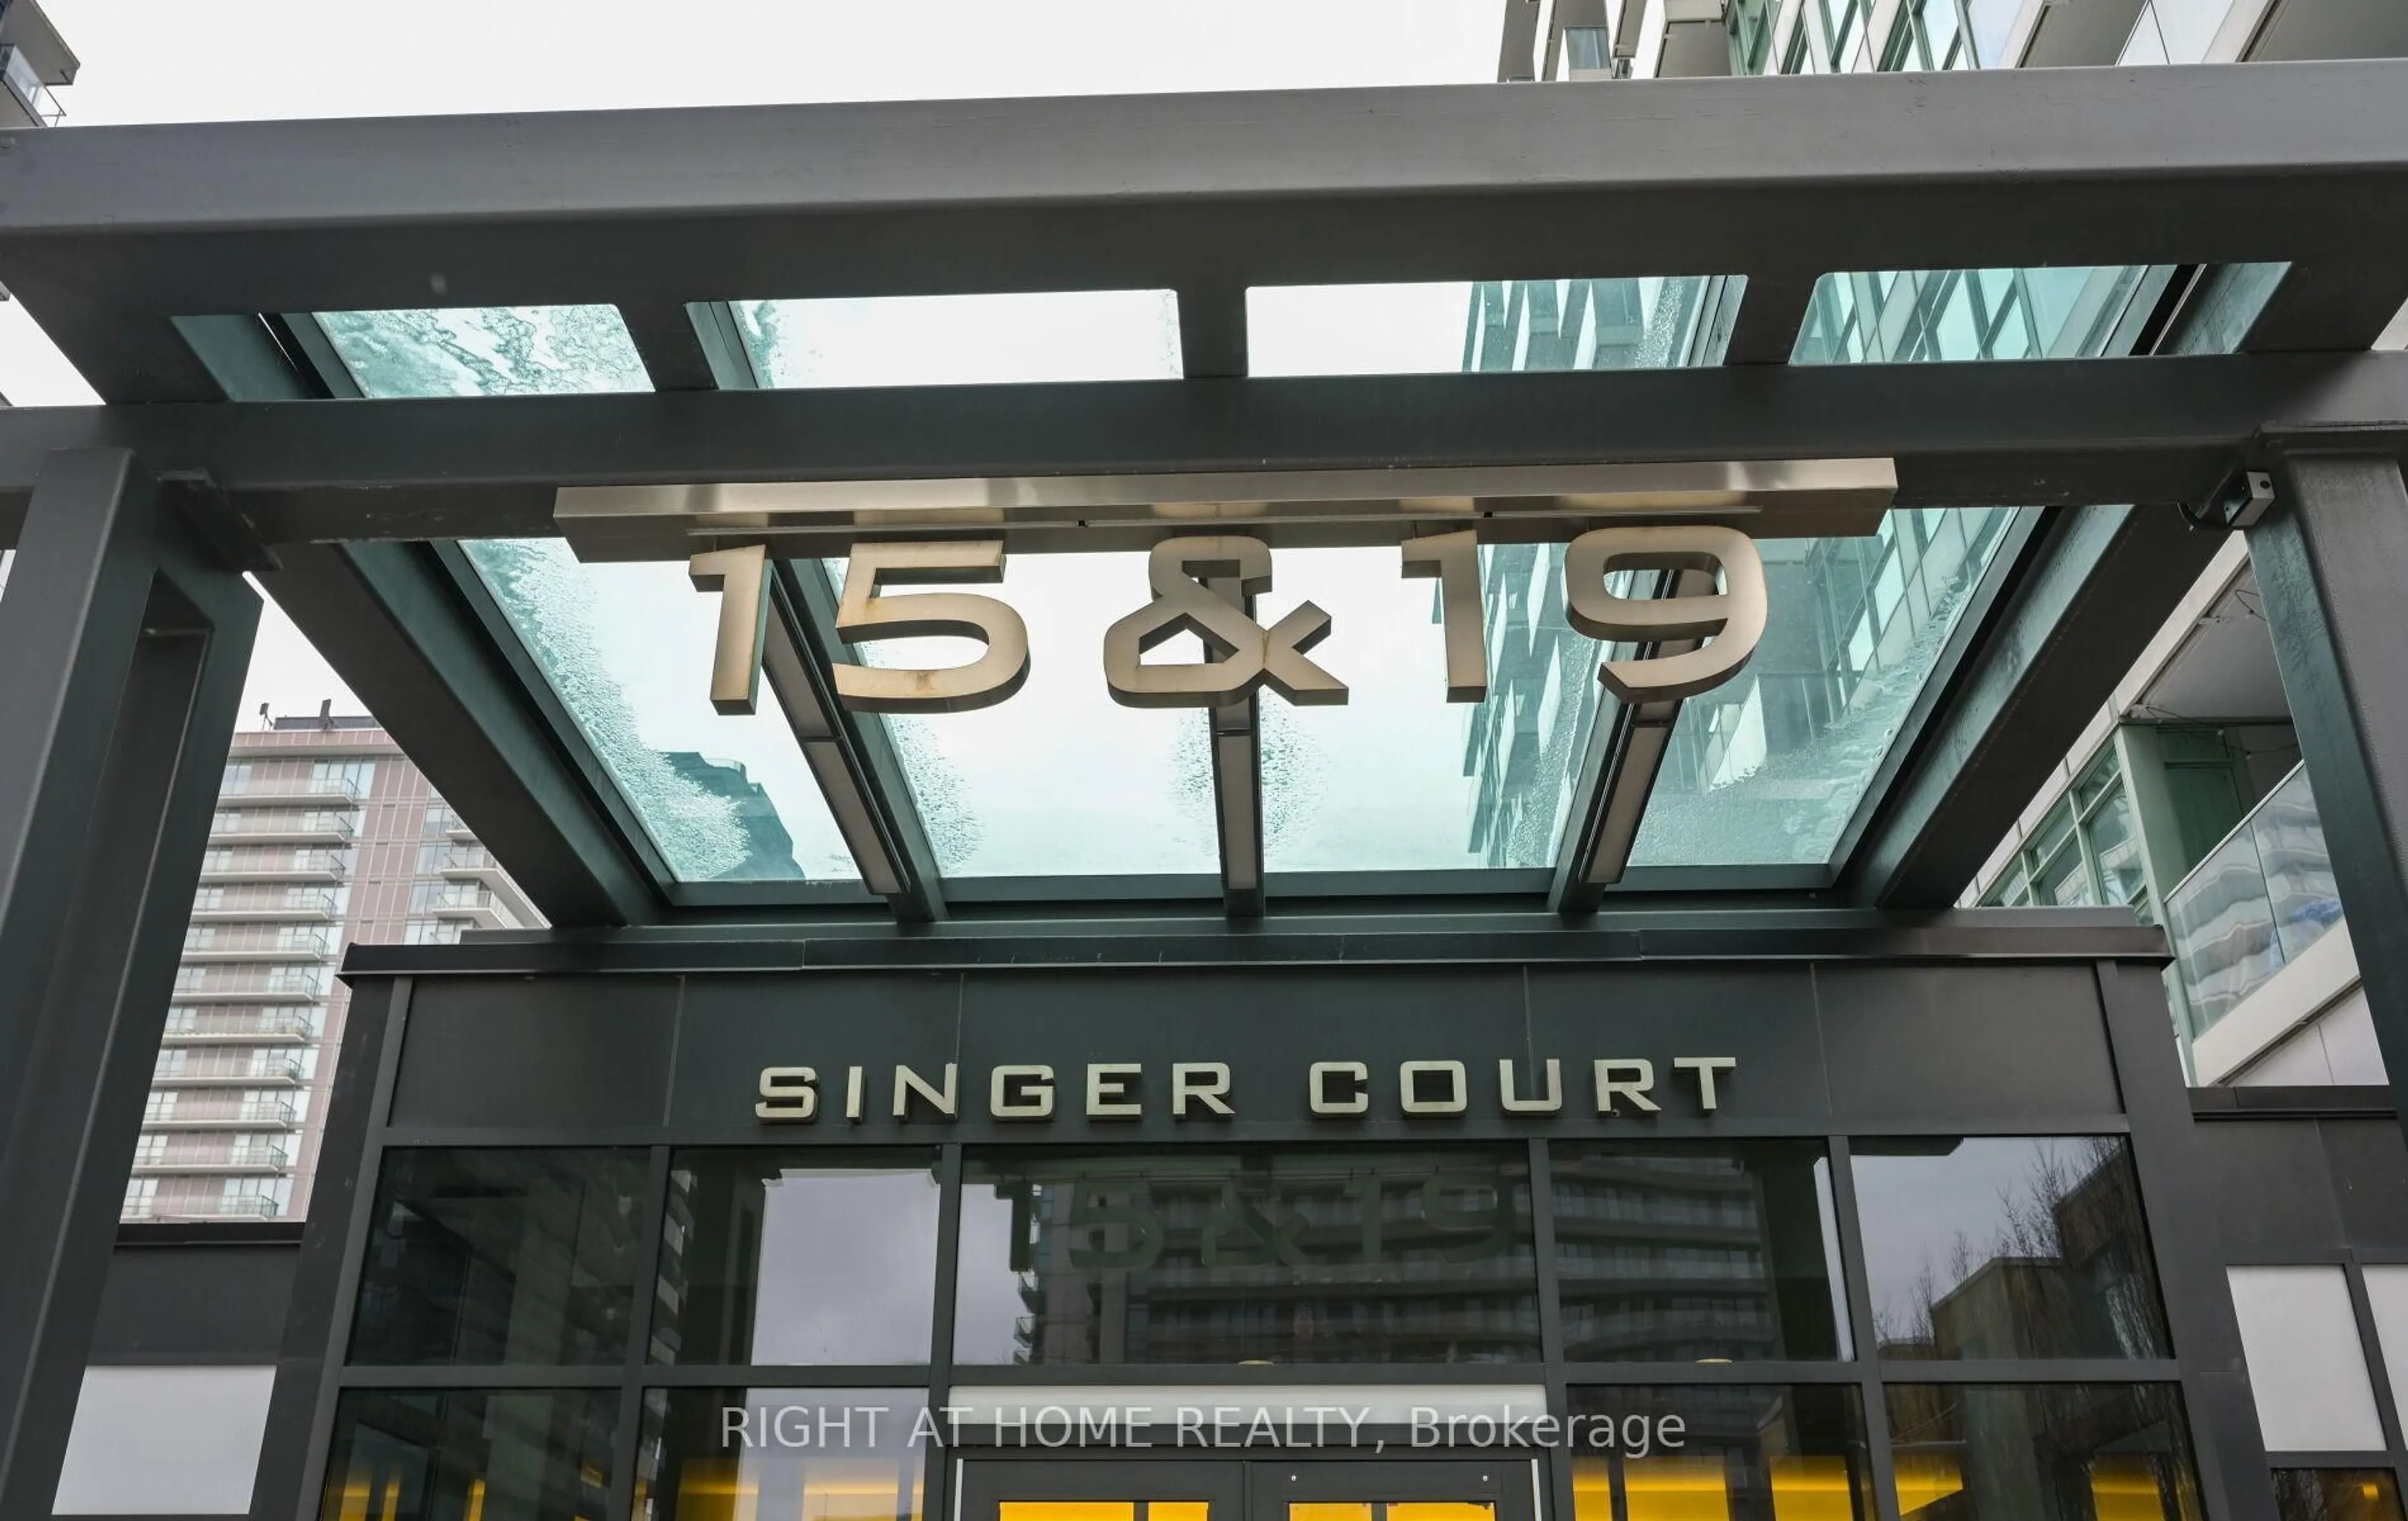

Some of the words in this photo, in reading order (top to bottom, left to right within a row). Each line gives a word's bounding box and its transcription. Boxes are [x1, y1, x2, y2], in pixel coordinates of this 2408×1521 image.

[689, 541, 1030, 714] 15
[1104, 536, 1349, 708] &
[1401, 526, 1767, 704] 19
[755, 1063, 1236, 1124] SINGER
[1309, 1057, 1736, 1116] COURT
